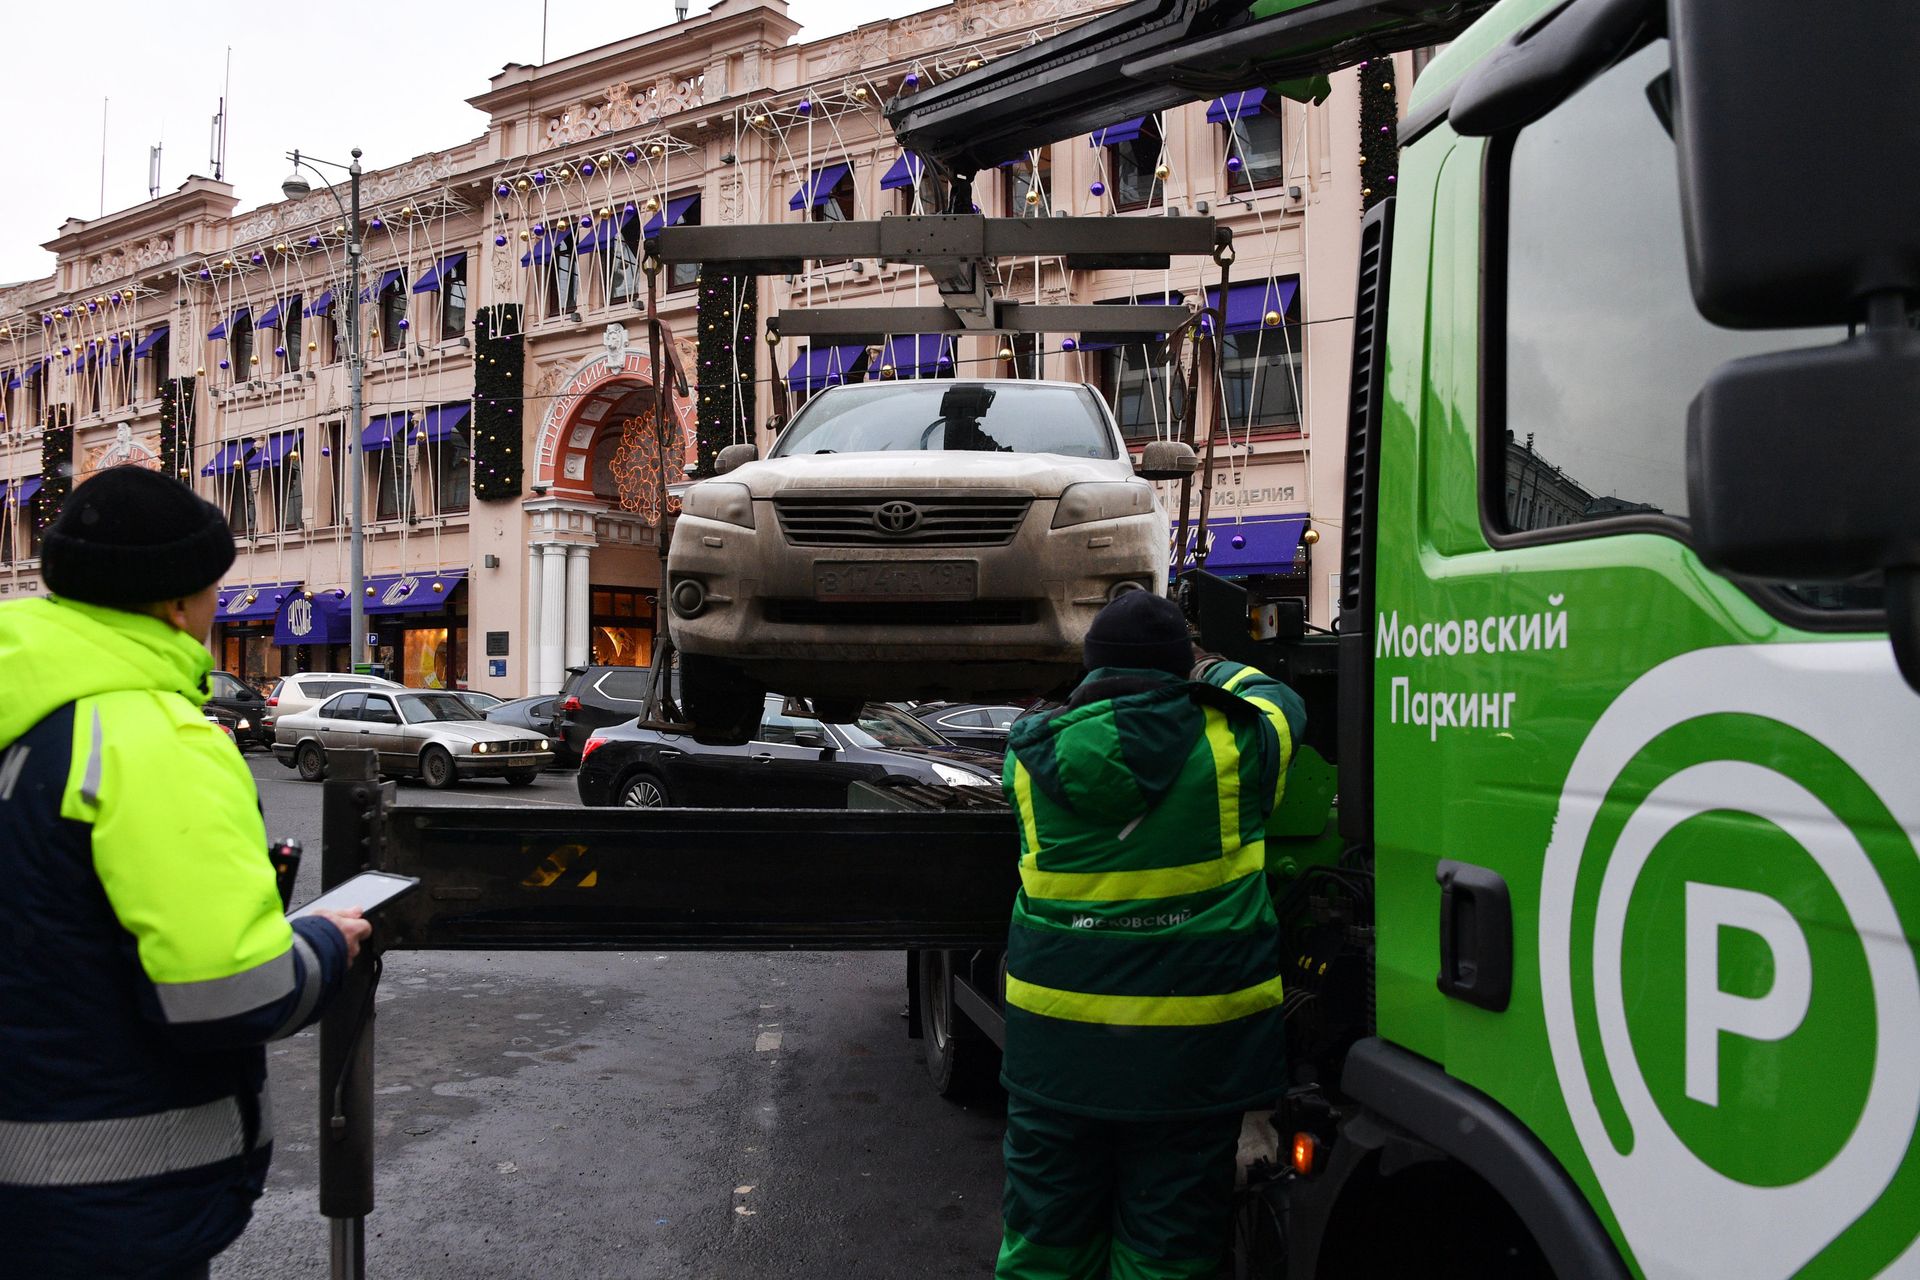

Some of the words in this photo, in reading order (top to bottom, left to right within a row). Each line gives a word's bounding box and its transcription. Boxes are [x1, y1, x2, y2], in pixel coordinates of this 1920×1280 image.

[1214, 486, 1294, 506] ИЗДЕЛИЯ
[1375, 592, 1568, 659] Московский
[1391, 676, 1516, 742] Паркинг
[1685, 880, 1813, 1108] P
